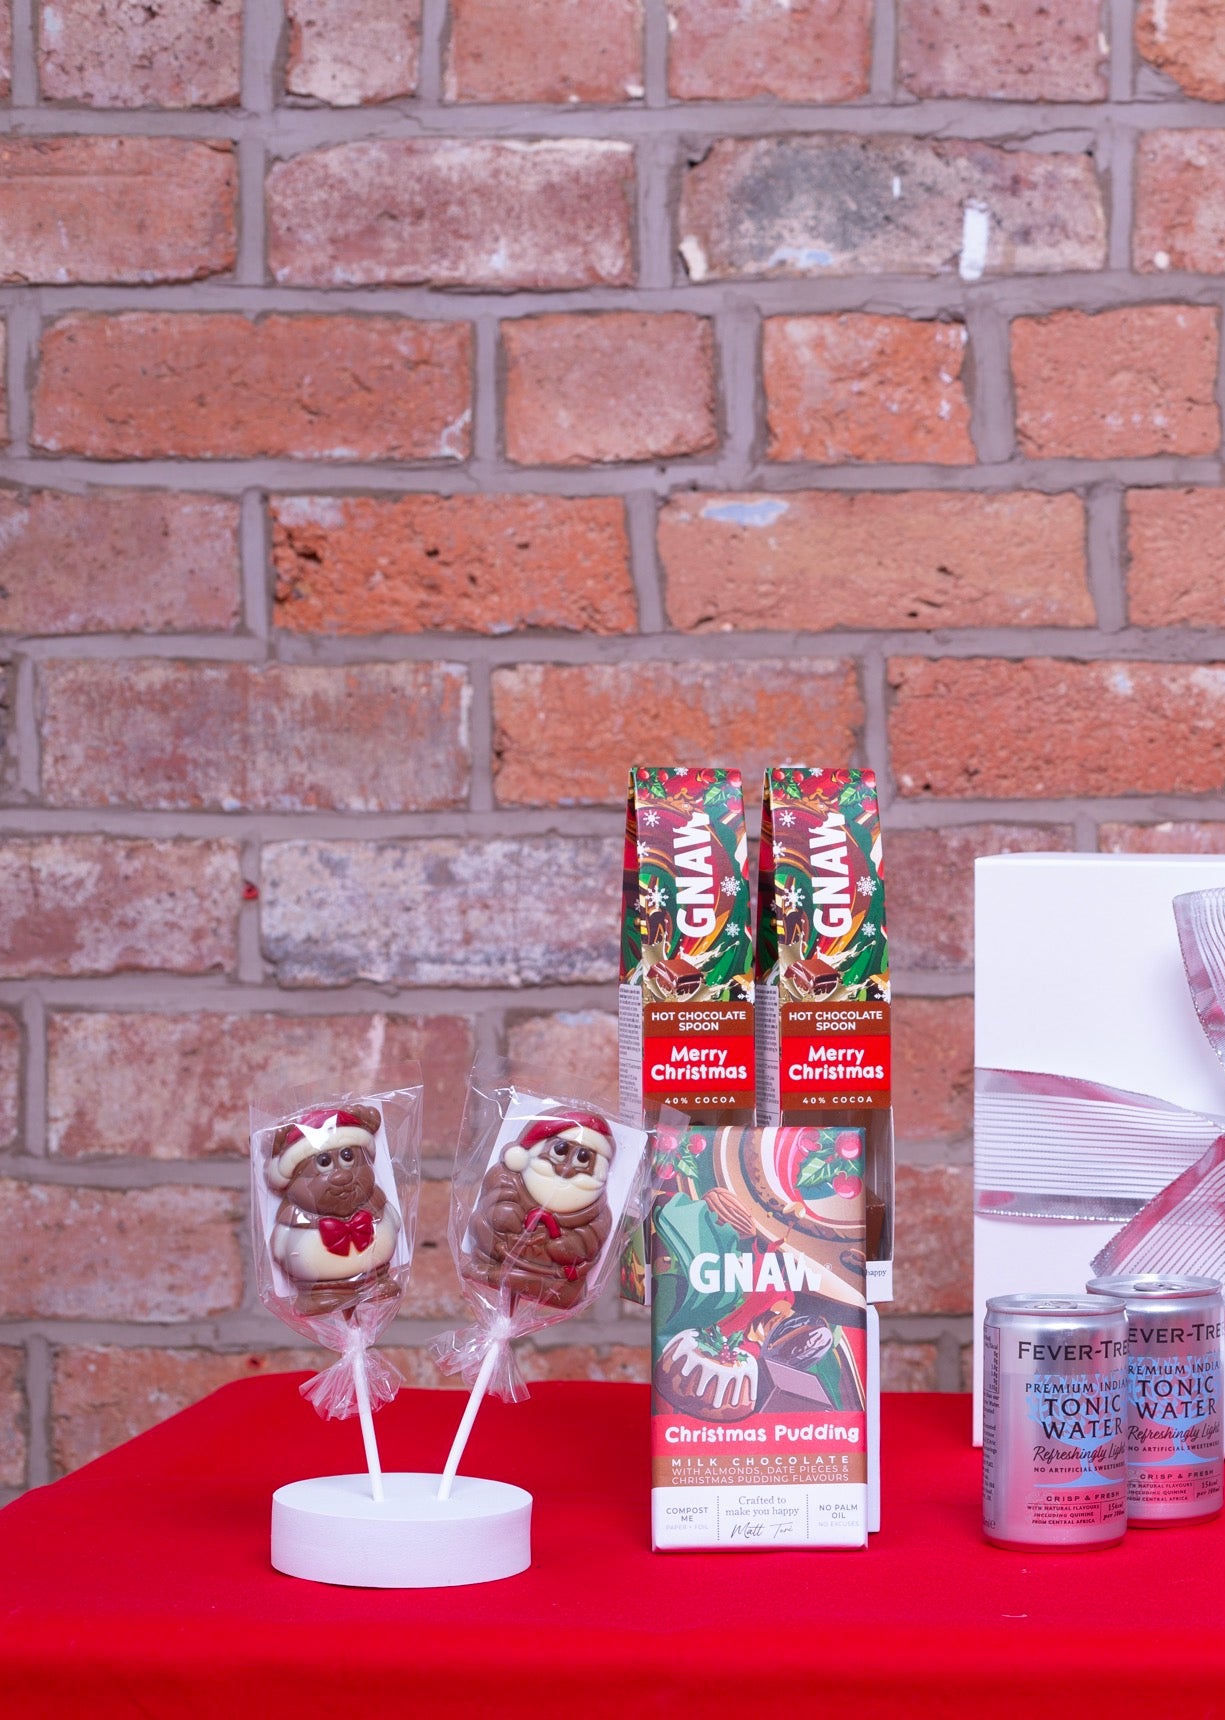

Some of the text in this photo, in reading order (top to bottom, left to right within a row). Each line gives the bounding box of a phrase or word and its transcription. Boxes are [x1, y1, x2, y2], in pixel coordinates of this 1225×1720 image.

[672, 811, 716, 938] GNAW
[808, 811, 852, 937] GNAW
[651, 1011, 747, 1021] HOT CHOCOLATE
[789, 1011, 883, 1021] HOT CHOCOLATE
[678, 1021, 719, 1031] SPOON
[816, 1021, 856, 1031] SPOON
[670, 1045, 728, 1065] Merry
[808, 1045, 865, 1065] Merry
[650, 1063, 747, 1081] Christmas
[788, 1063, 885, 1081] Christmas
[664, 1096, 736, 1105] 40% COCOA
[802, 1096, 873, 1105] 40% COCOA
[689, 1252, 822, 1294] GNAW
[1128, 1365, 1185, 1375] REMIUM
[1025, 1382, 1094, 1394] PREMIUM
[1137, 1375, 1214, 1397] TONIC
[1043, 1394, 1121, 1417] TONIC
[1135, 1398, 1216, 1420] WATER
[665, 1424, 860, 1443] Christmas Pudding
[1041, 1417, 1123, 1440] WATER
[1127, 1425, 1200, 1444] Refreshingly
[672, 1456, 849, 1467] MILK CHOCOLATE
[1033, 1446, 1107, 1464] Refreshingly
[672, 1465, 849, 1476] WITH ALMONDS, DATE PIECES &
[1188, 1470, 1214, 1478] FRESH
[672, 1474, 849, 1485] CHRISTMAS PUDDING FLAVOURS
[738, 1495, 787, 1505] Crafted to
[725, 1506, 800, 1517] make you happy
